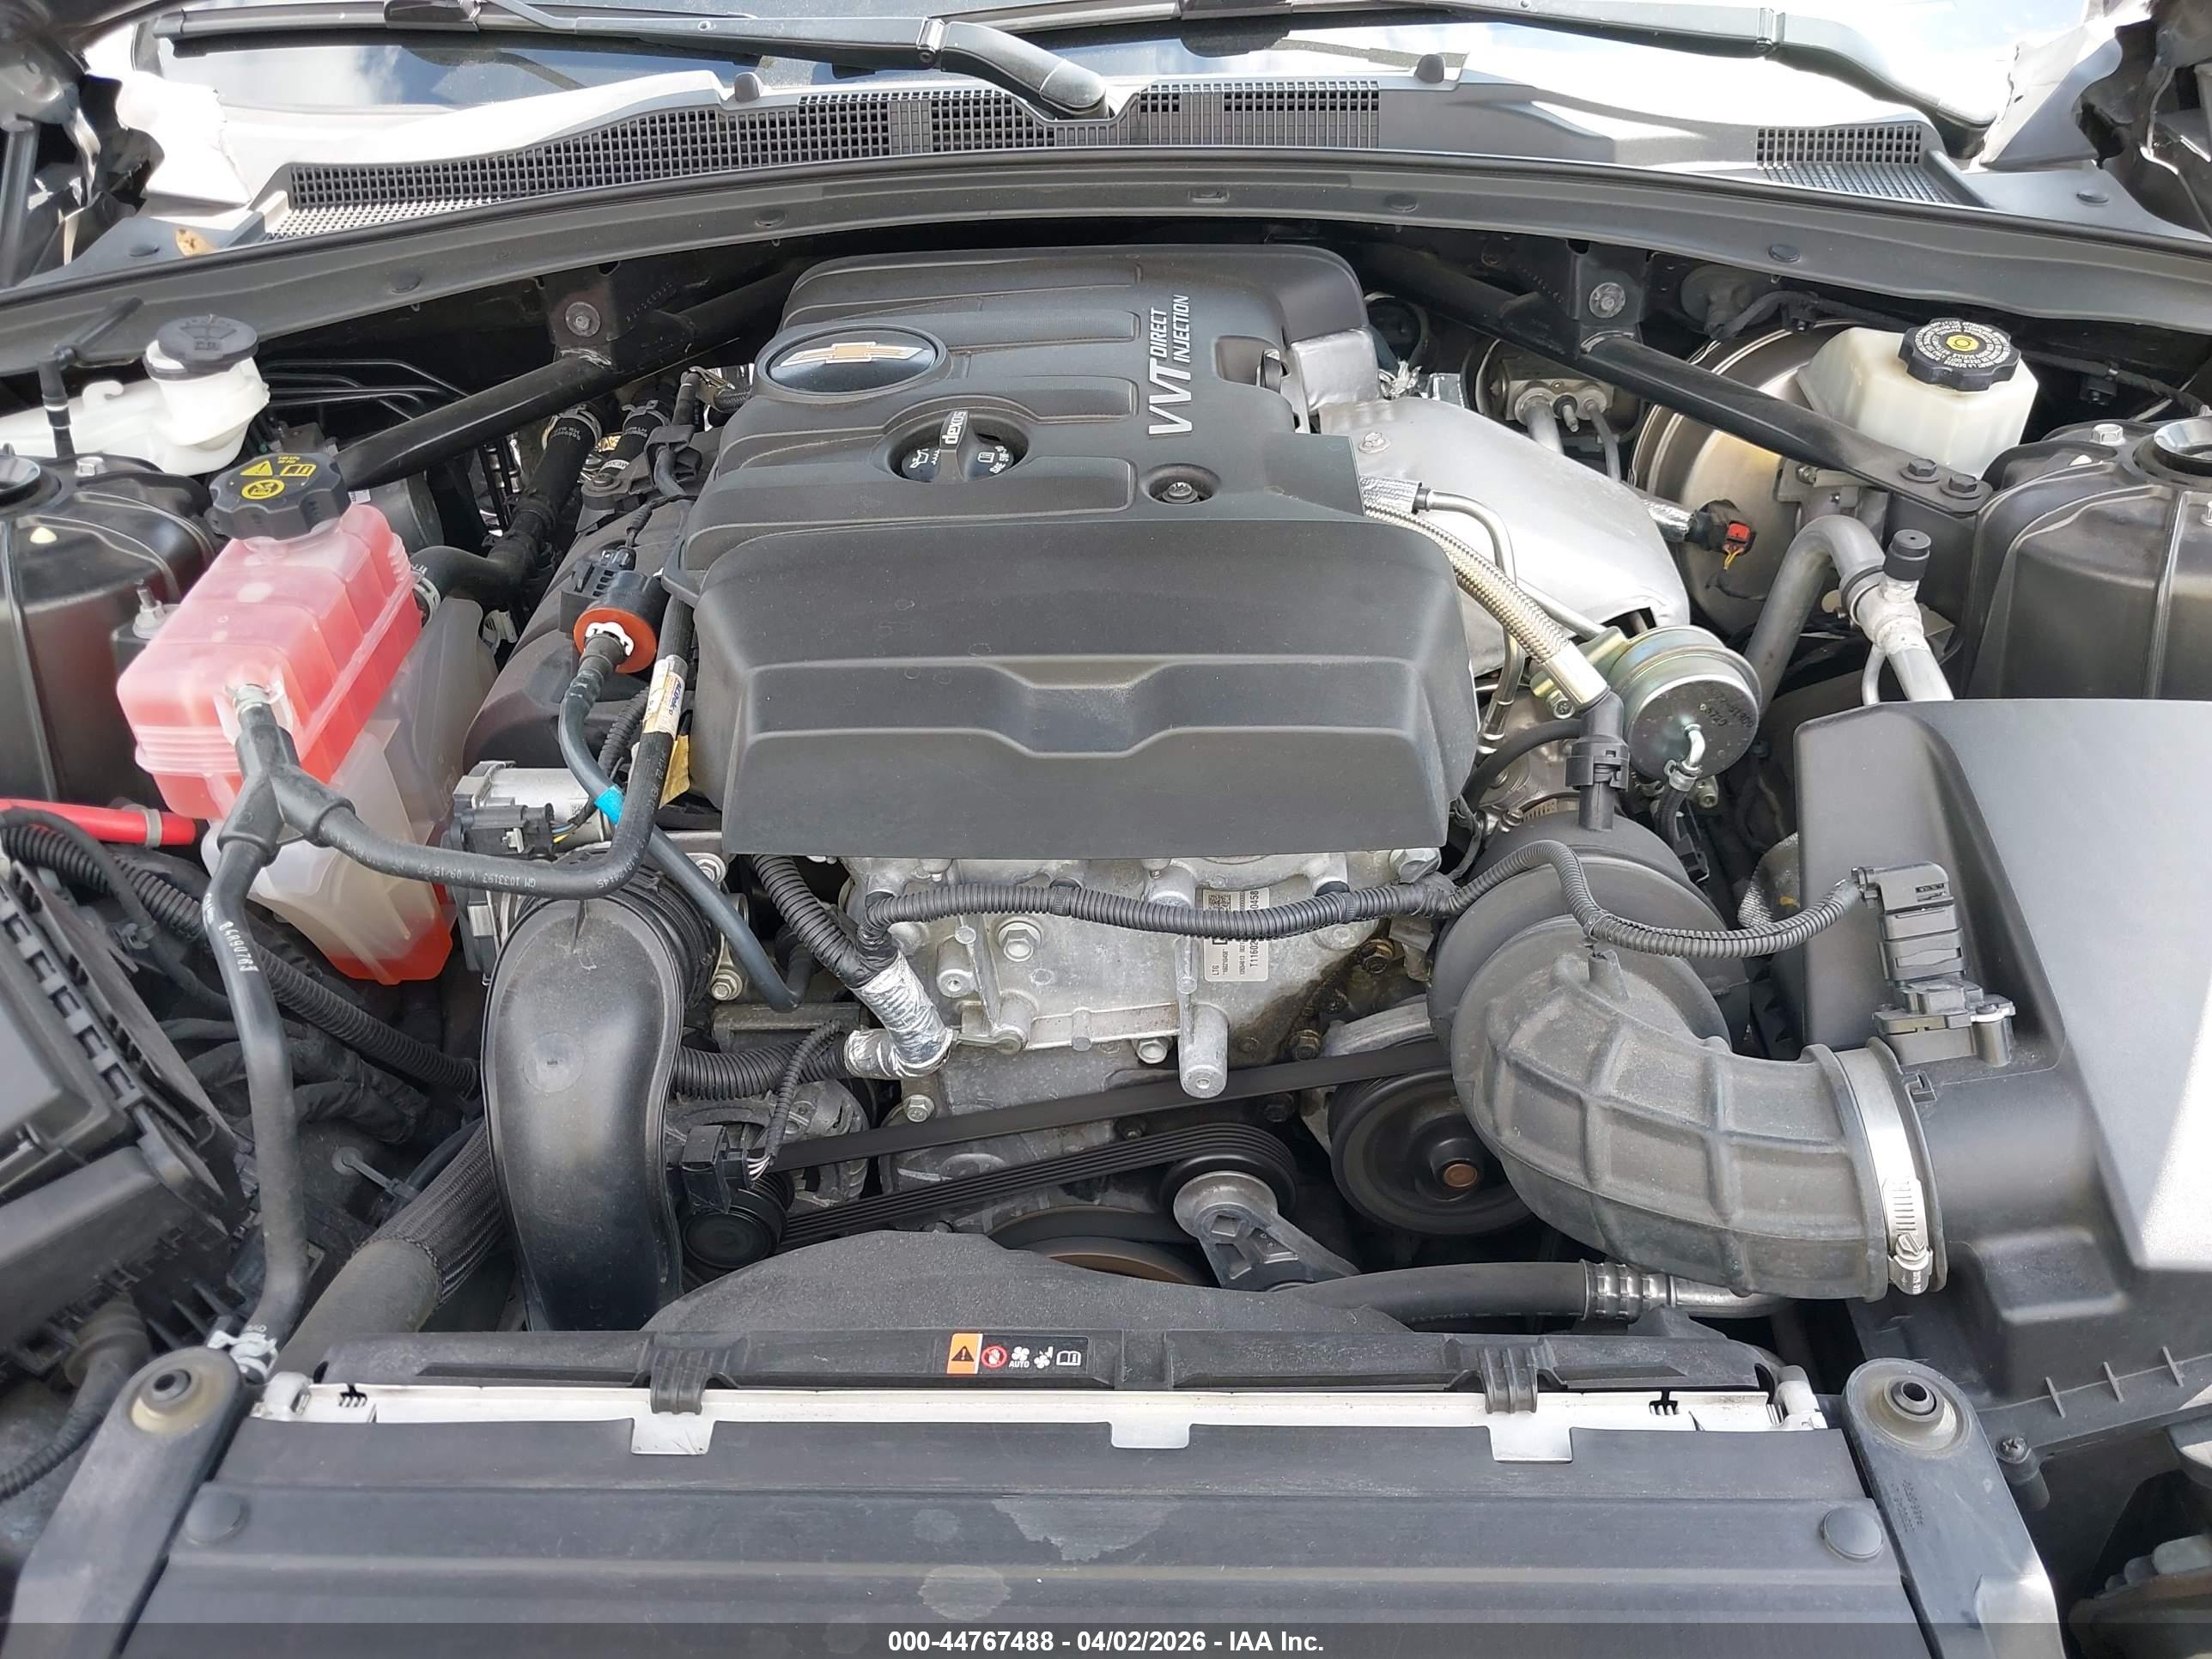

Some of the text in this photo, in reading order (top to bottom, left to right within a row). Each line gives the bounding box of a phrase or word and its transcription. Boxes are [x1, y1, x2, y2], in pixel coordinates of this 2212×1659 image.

[1149, 307, 1168, 358] DIRECT
[1172, 295, 1191, 363] INJECTION
[1147, 357, 1193, 435] VVT
[941, 411, 967, 445] dexos
[988, 462, 1006, 474] SAE
[524, 878, 537, 888] GM
